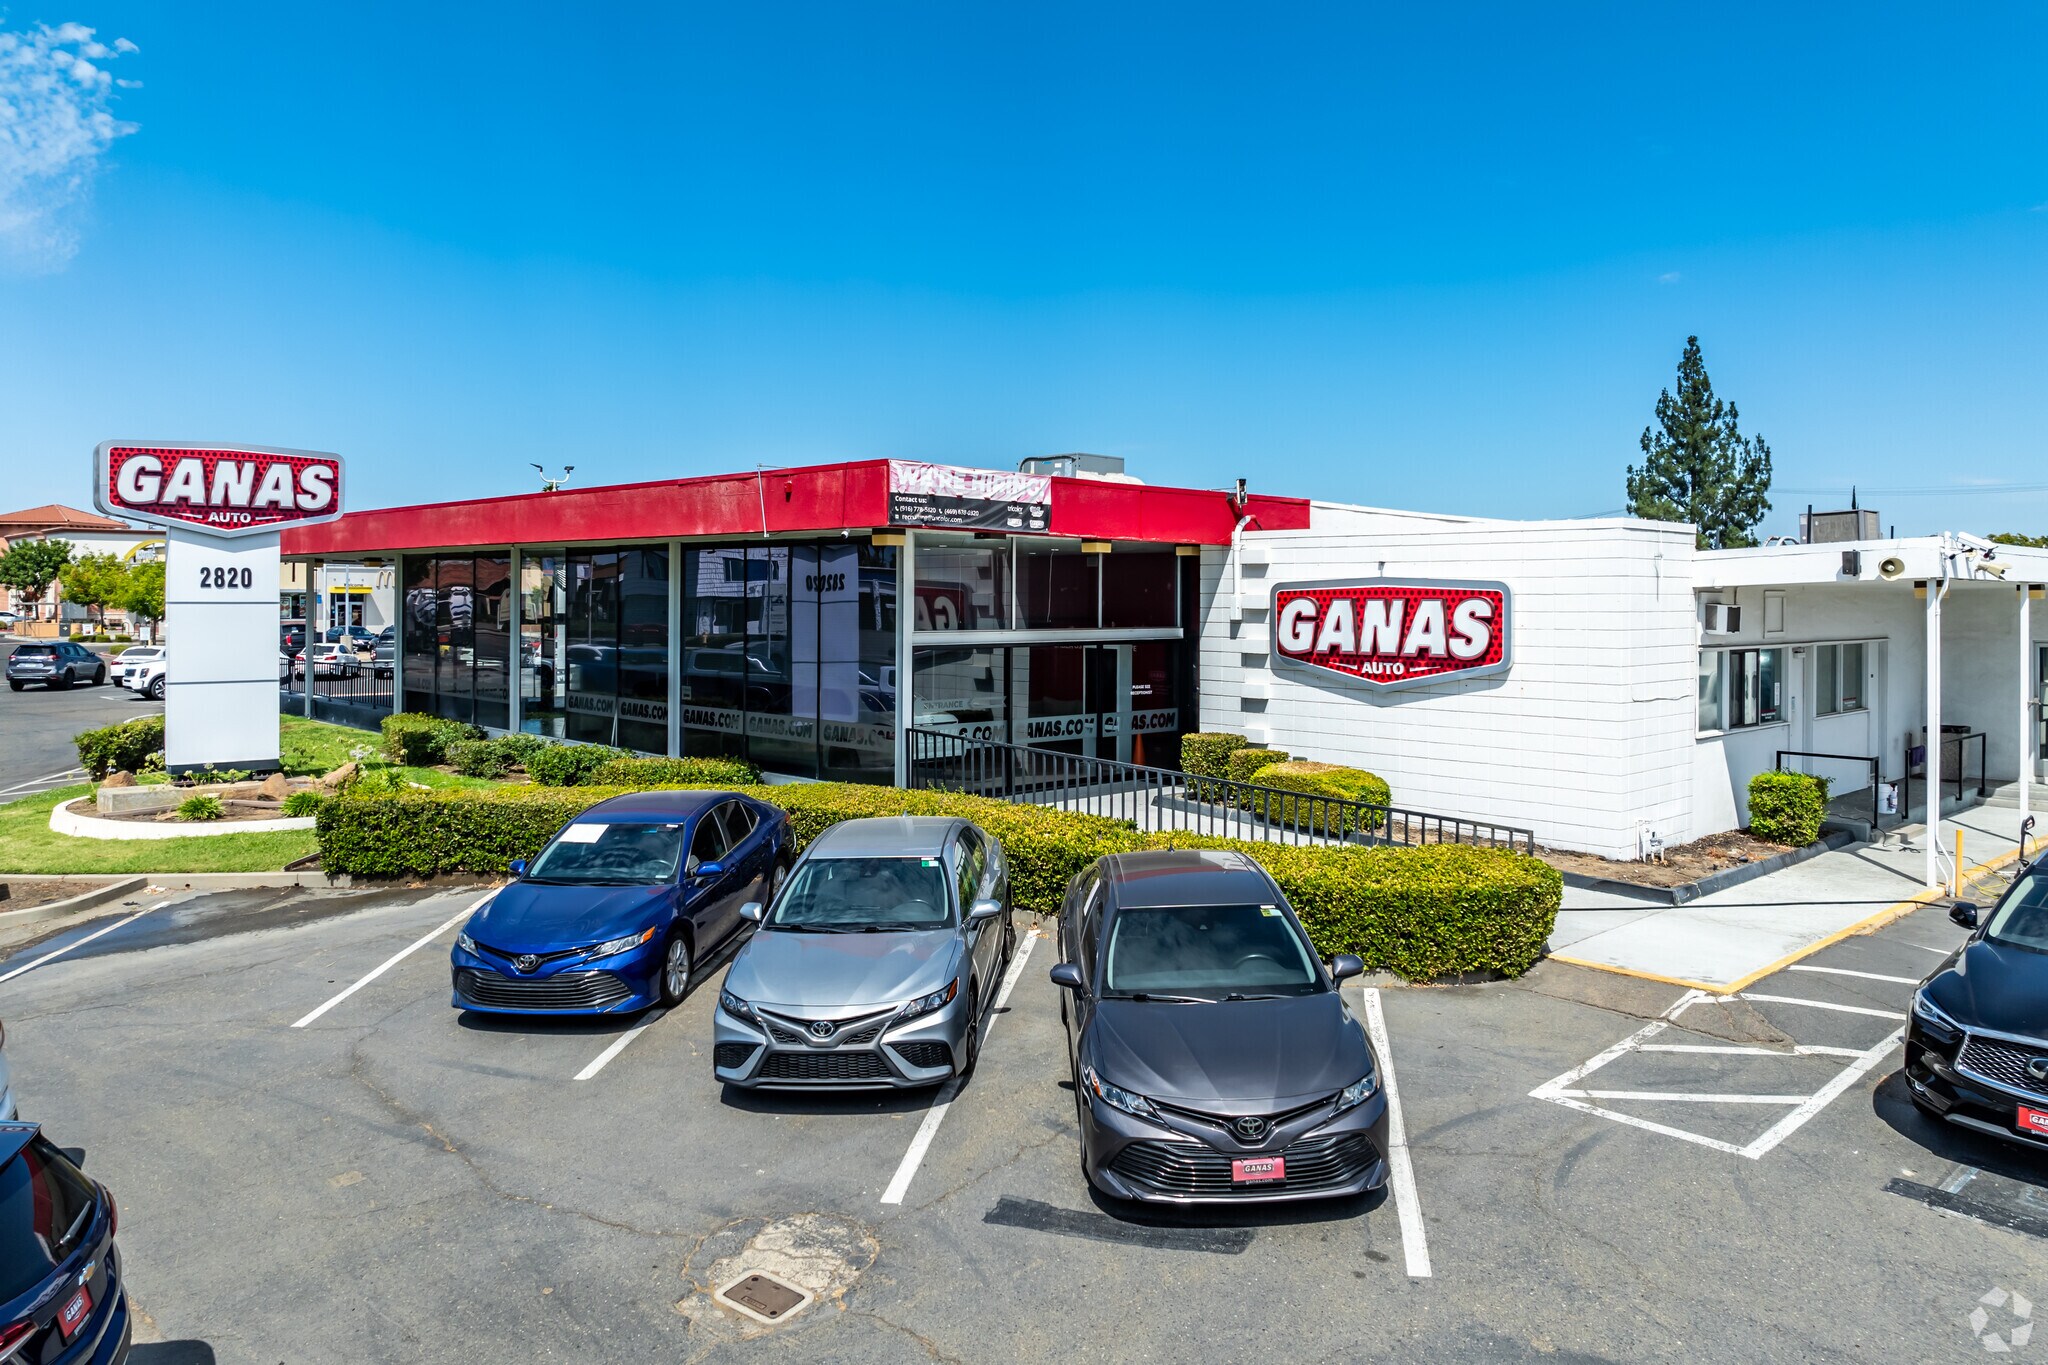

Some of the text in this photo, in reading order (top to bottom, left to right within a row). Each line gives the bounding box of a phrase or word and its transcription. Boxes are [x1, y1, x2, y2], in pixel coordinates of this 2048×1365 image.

[116, 454, 334, 511] GANAS
[895, 495, 917, 503] Contact
[208, 512, 251, 523] AUTO
[200, 566, 252, 589] 2820
[1278, 596, 1496, 661] GANAS
[1361, 661, 1405, 675] AUTO
[568, 695, 614, 713] GANAS.COM
[683, 708, 740, 729] GANAS.COM
[749, 716, 815, 739] GANAS.COM
[1027, 718, 1095, 739] ANAS.COM
[1244, 1164, 1272, 1172] GANAS
[66, 1296, 83, 1320] GANAS
